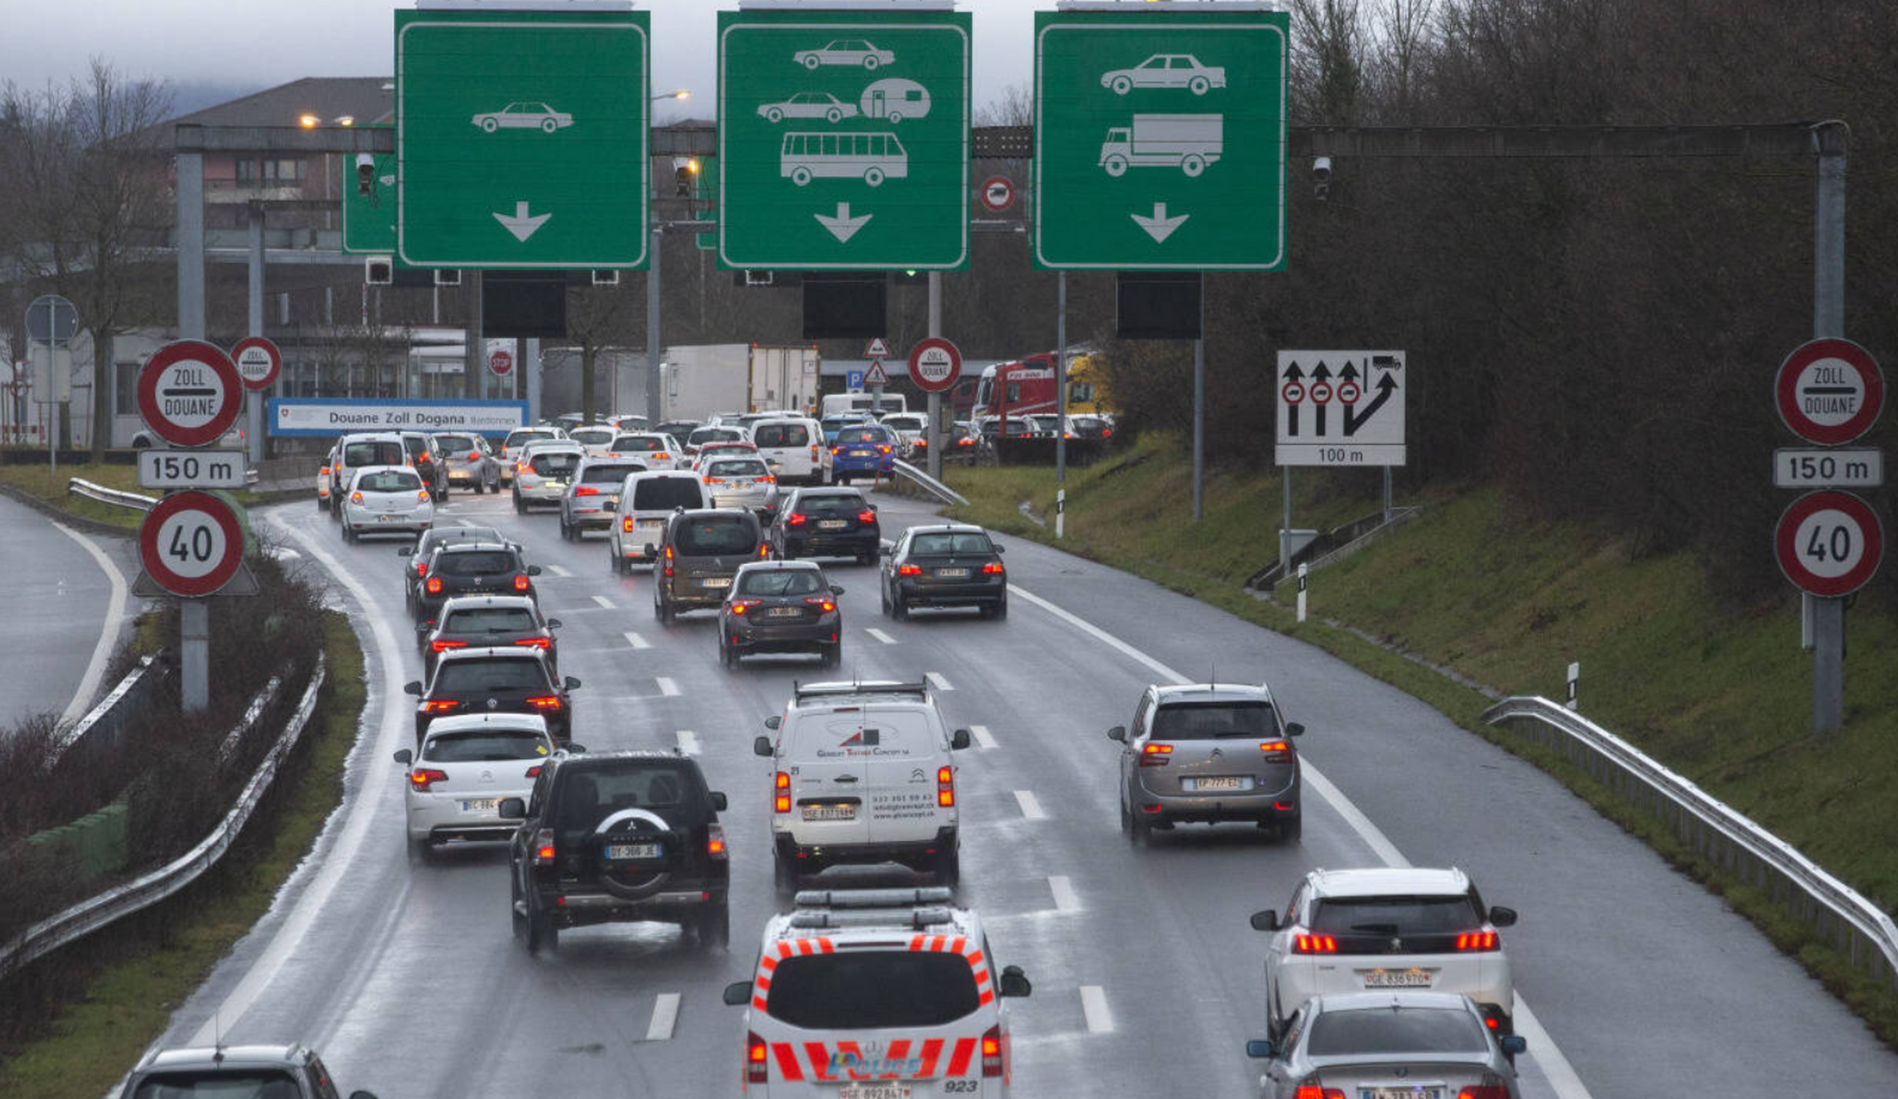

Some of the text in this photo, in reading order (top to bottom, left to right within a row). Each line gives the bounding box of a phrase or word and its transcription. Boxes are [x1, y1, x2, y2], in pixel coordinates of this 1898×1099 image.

[247, 351, 263, 360] ZOLL
[492, 358, 510, 368] STOP
[927, 351, 943, 360] ZOLL
[174, 369, 205, 386] ZOLL
[922, 367, 947, 376] DOUANE
[1814, 368, 1846, 385] ZOLL
[851, 373, 860, 387] P
[165, 399, 216, 416] DOUANE
[1805, 397, 1856, 415] DOUANE
[329, 412, 379, 424] Douane
[386, 412, 410, 424] Zoll
[416, 413, 465, 427] Dogana
[1319, 448, 1363, 462] 100 m
[153, 457, 231, 480] 150 m
[1790, 457, 1868, 479] 150 m
[170, 525, 212, 562] 40
[1807, 526, 1850, 562] 40
[944, 1080, 978, 1094] 923
